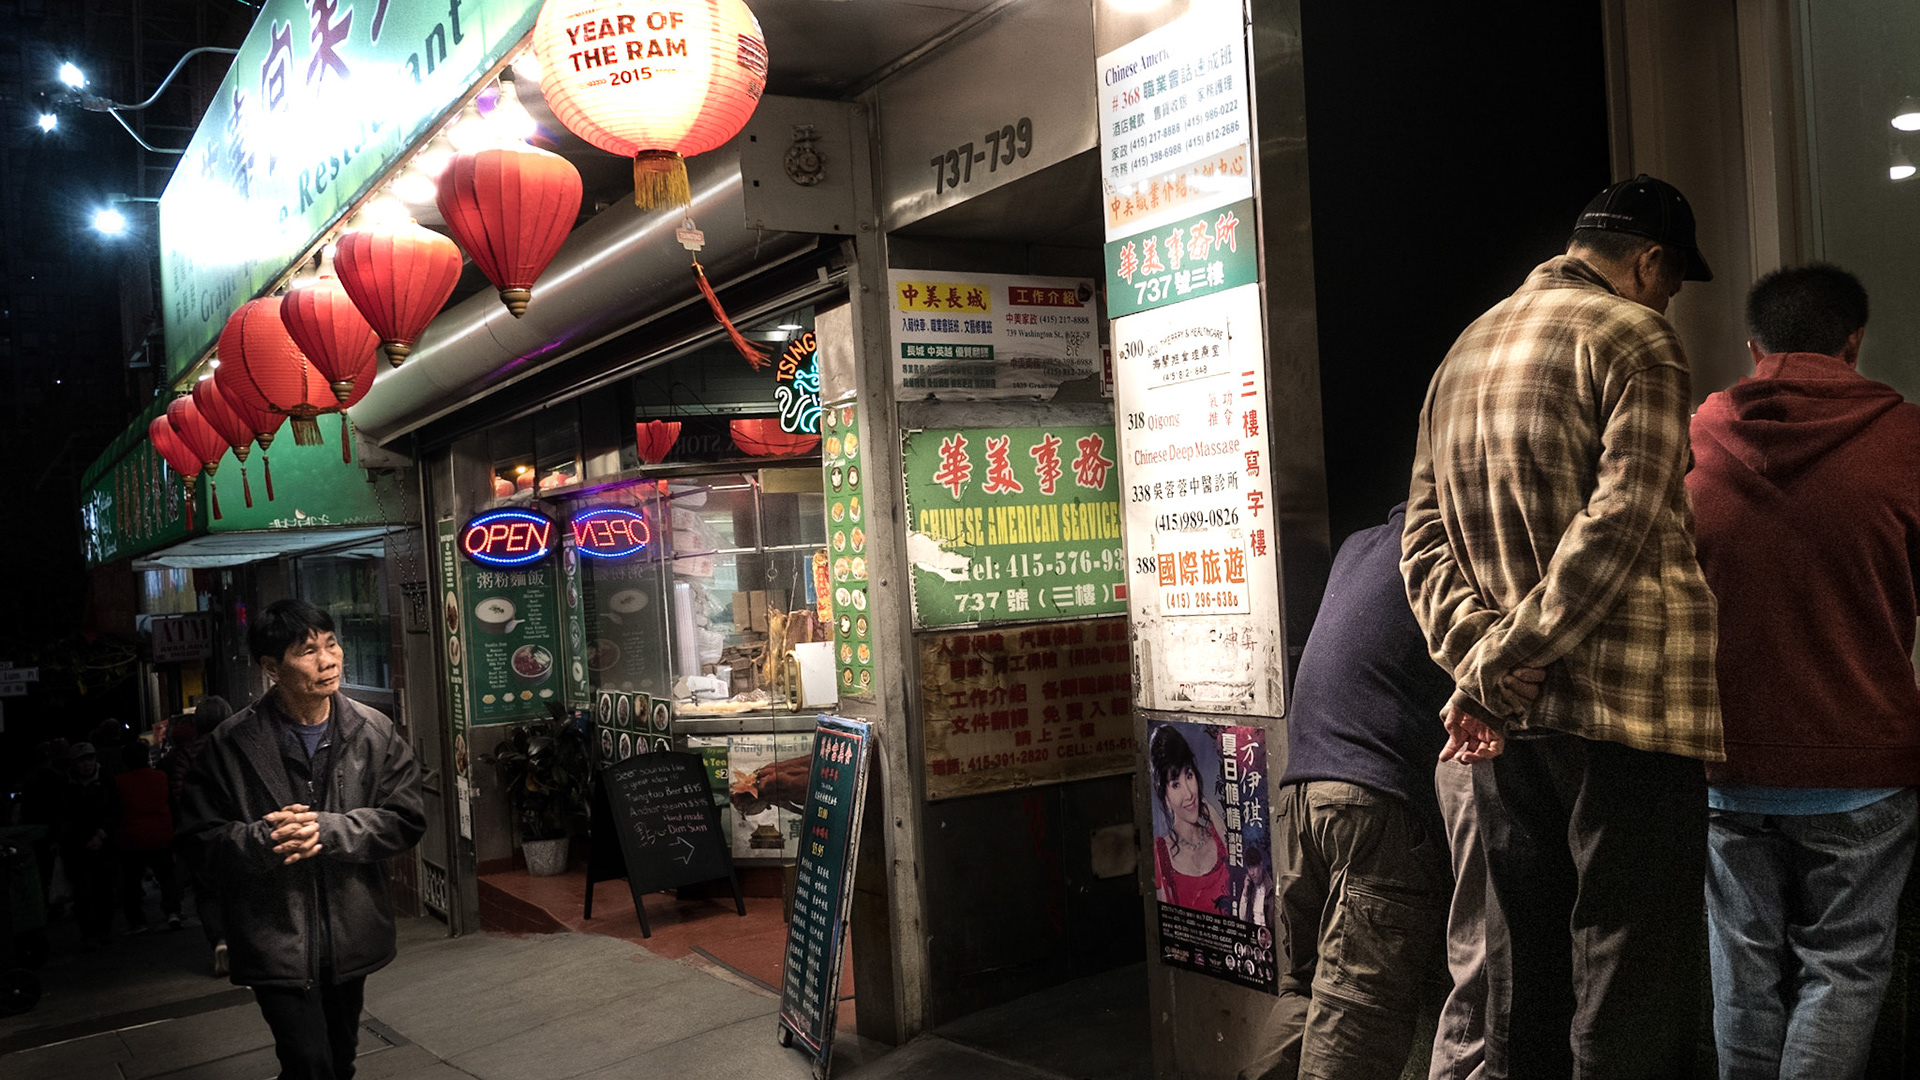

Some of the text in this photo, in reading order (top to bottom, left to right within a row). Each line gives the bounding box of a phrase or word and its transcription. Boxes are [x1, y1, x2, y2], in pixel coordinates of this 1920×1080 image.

[566, 11, 684, 46] YEAR OF
[569, 38, 688, 72] THE RAM
[609, 66, 652, 86] 2015
[1105, 61, 1138, 87] Chinese
[1129, 136, 1148, 153] (415)
[1149, 123, 1181, 145] 217-8888
[1184, 114, 1204, 131] (415)
[930, 117, 1033, 195] 737-739
[1130, 153, 1149, 170] (415)
[1185, 135, 1205, 152] (415)
[1117, 211, 1240, 285] 華美事務所
[901, 284, 1076, 311] 中美長城 工作介紹
[1039, 315, 1059, 326] (415)
[1059, 316, 1090, 325] 217-8888
[1006, 329, 1018, 338] 739
[1018, 329, 1054, 341] Washington
[1124, 339, 1145, 360] 300
[1127, 411, 1146, 431] 318
[1134, 438, 1241, 466] Chinese Deep Massage
[1240, 370, 1268, 558] 三樓寫字樓
[933, 432, 1114, 500] 華美事務
[1131, 484, 1152, 503] 338
[464, 522, 551, 554] OPEN
[920, 506, 985, 549] CHINESE
[987, 503, 1060, 546] AMERICAN
[476, 569, 545, 590] 粥粉麵飯
[1135, 547, 1246, 588] 388 國際旅遊
[1166, 591, 1192, 610] (415)
[162, 618, 209, 643] ATM
[950, 683, 1028, 710] 工作介紹
[967, 748, 1049, 771] 415-391-2820
[1056, 742, 1093, 759] CELL:
[665, 785, 683, 796] Beer
[1239, 734, 1263, 830] 方伊琪
[629, 803, 661, 818] Anchor
[683, 810, 705, 821] made
[667, 822, 708, 834] Dim Sum
